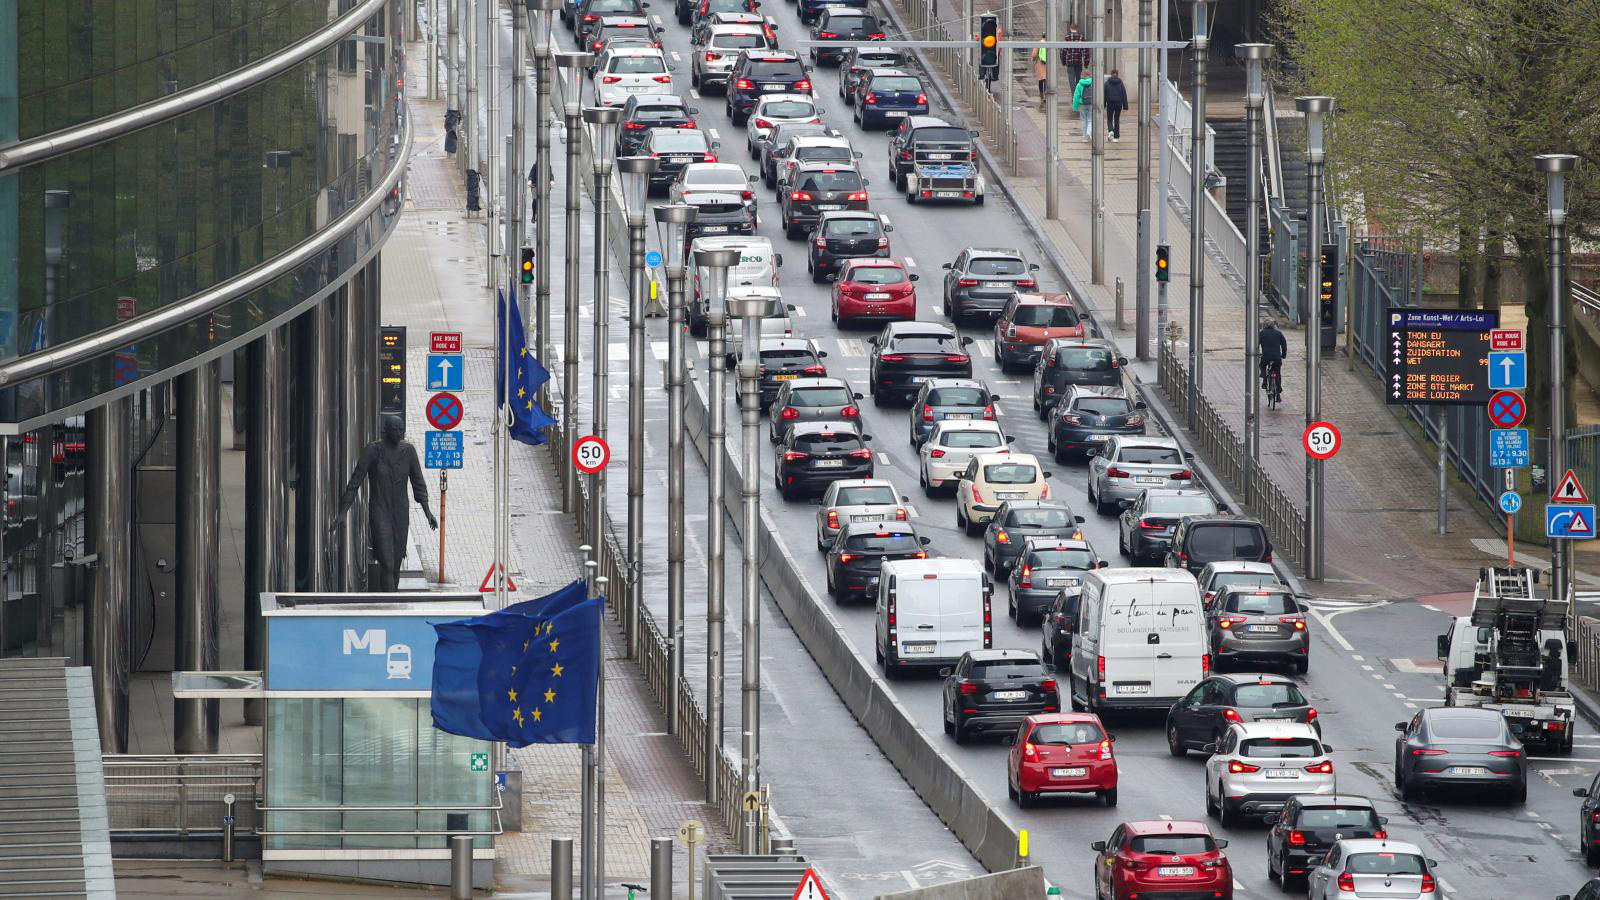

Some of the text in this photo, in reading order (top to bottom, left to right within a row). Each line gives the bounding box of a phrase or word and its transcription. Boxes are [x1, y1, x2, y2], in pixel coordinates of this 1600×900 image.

[1312, 432, 1332, 445] 50
[581, 446, 601, 459] 50
[343, 629, 386, 655] M
